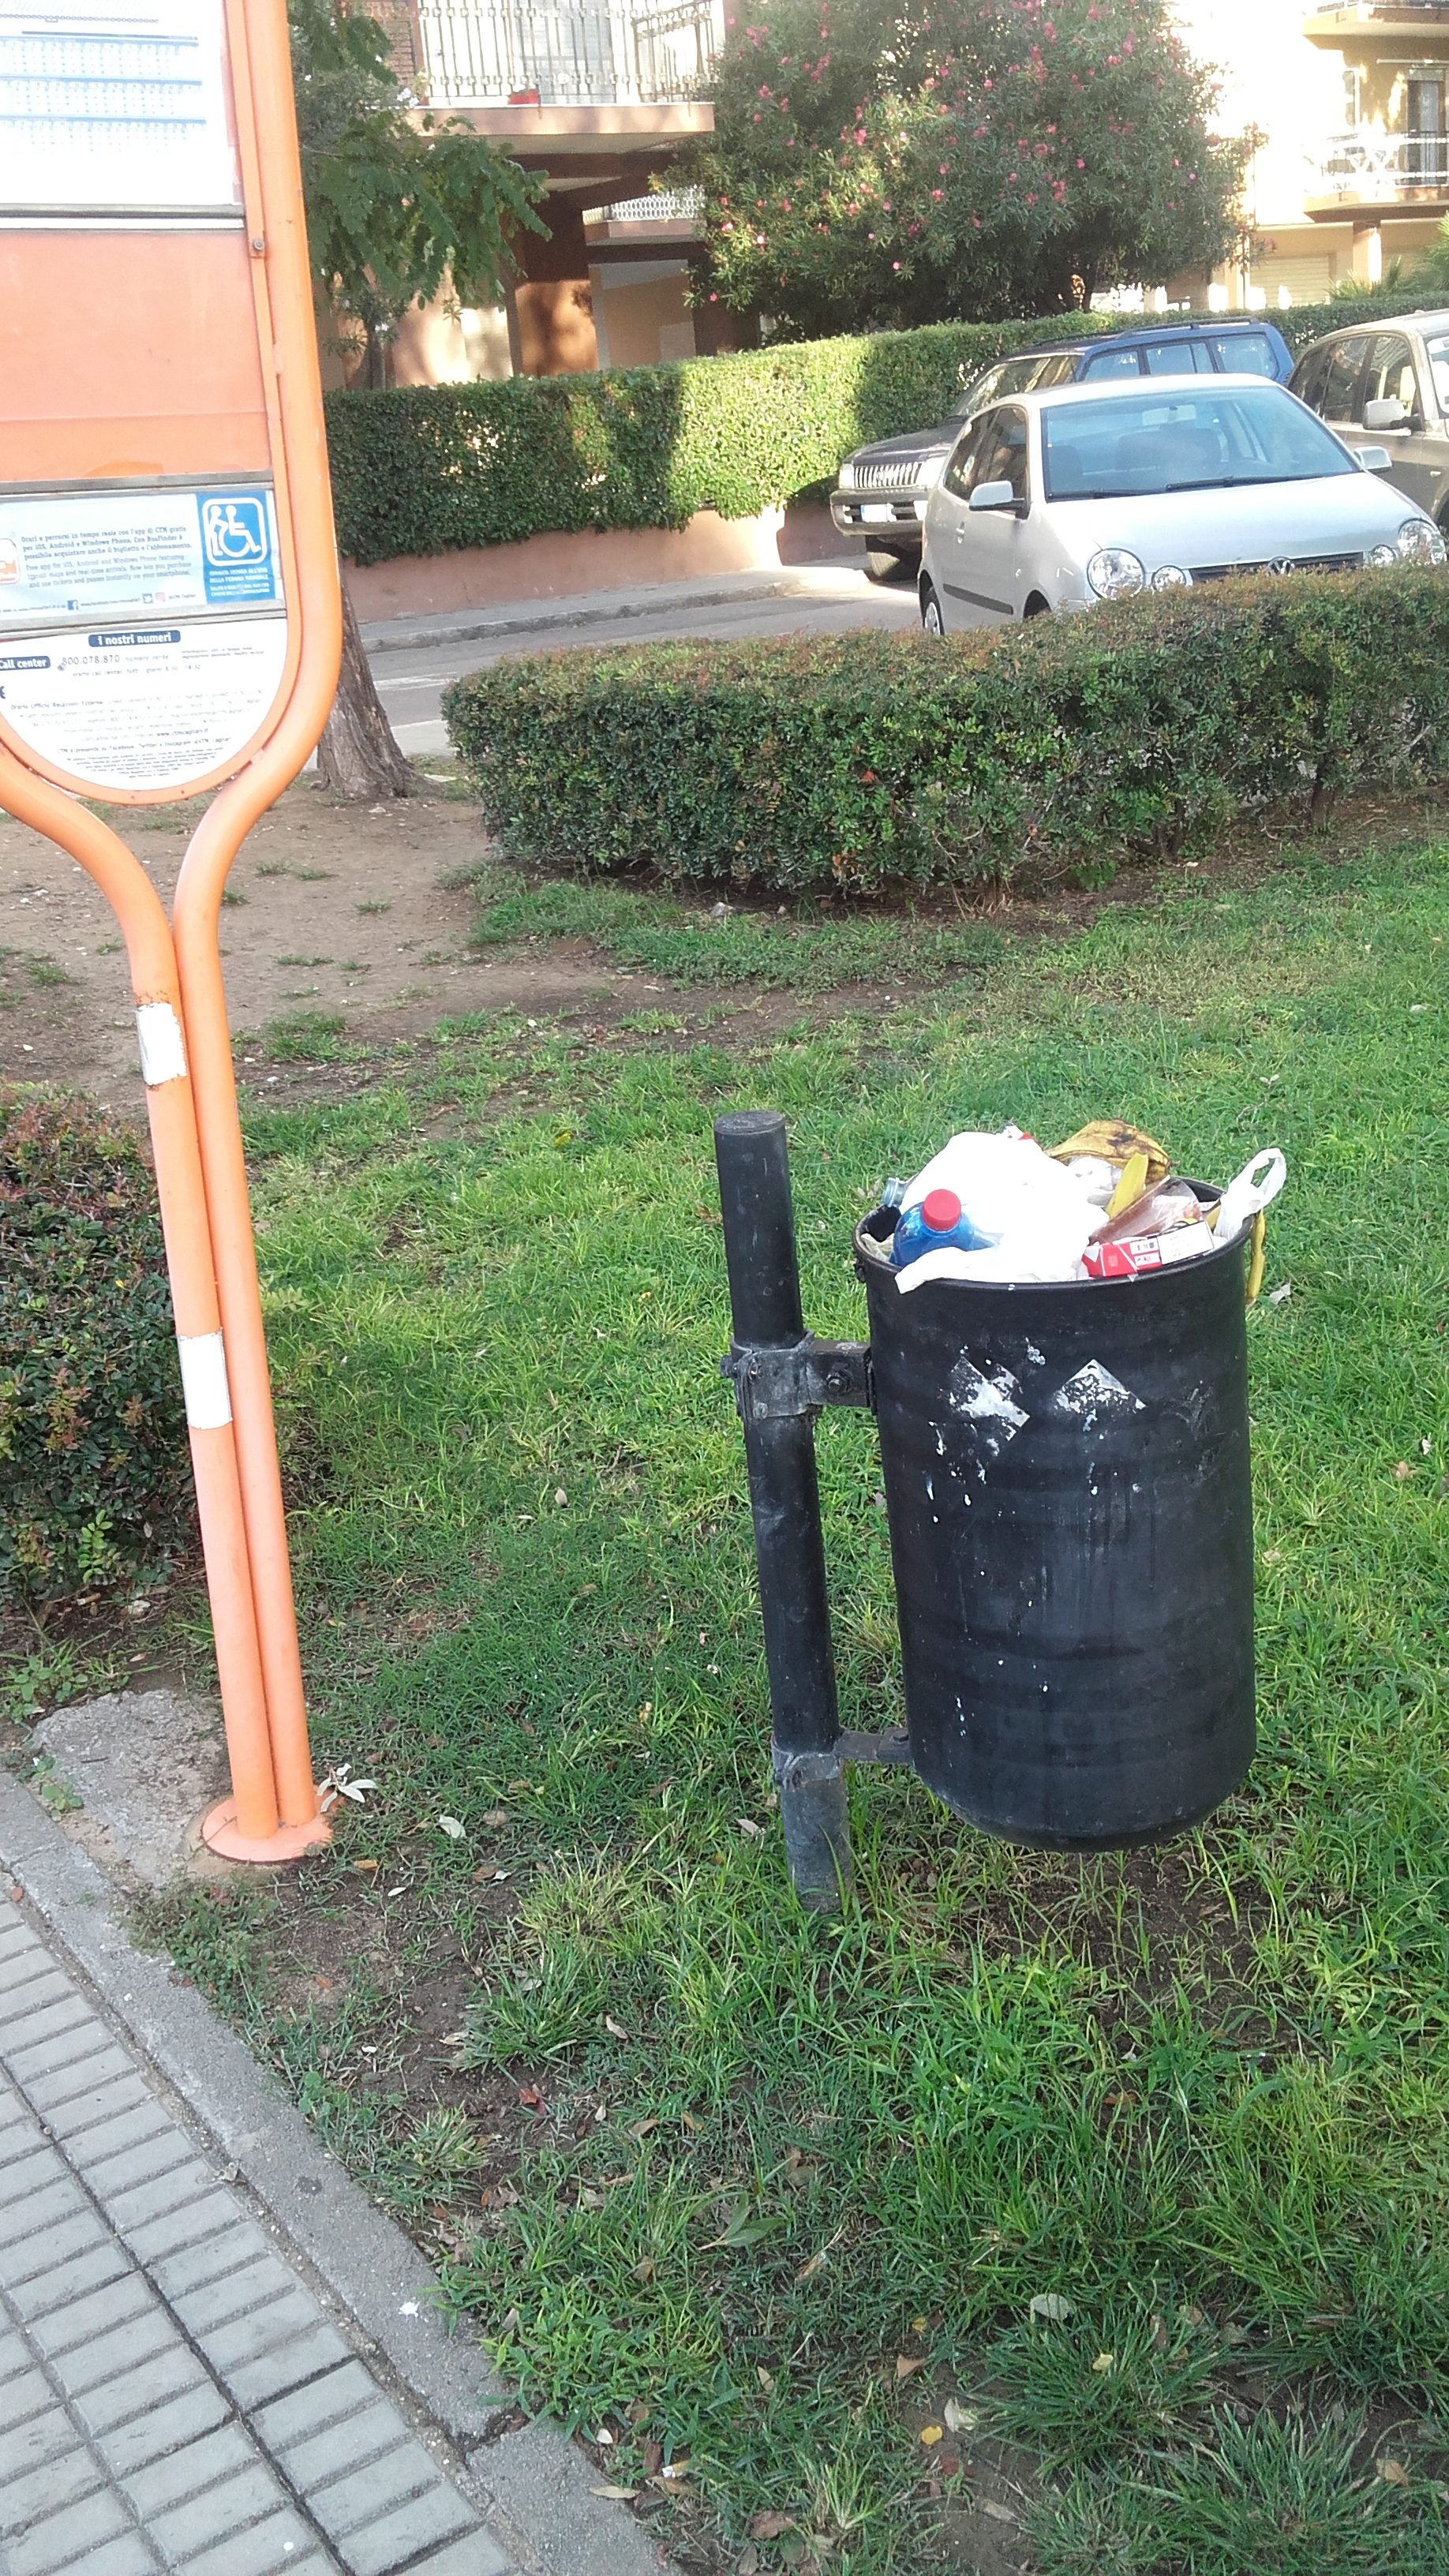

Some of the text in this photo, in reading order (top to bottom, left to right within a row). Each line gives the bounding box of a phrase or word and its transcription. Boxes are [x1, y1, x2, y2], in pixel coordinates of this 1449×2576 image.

[105, 634, 135, 645] nostri
[137, 632, 172, 644] numeri
[17, 658, 47, 668] center
[62, 654, 120, 666] 800.078.870
